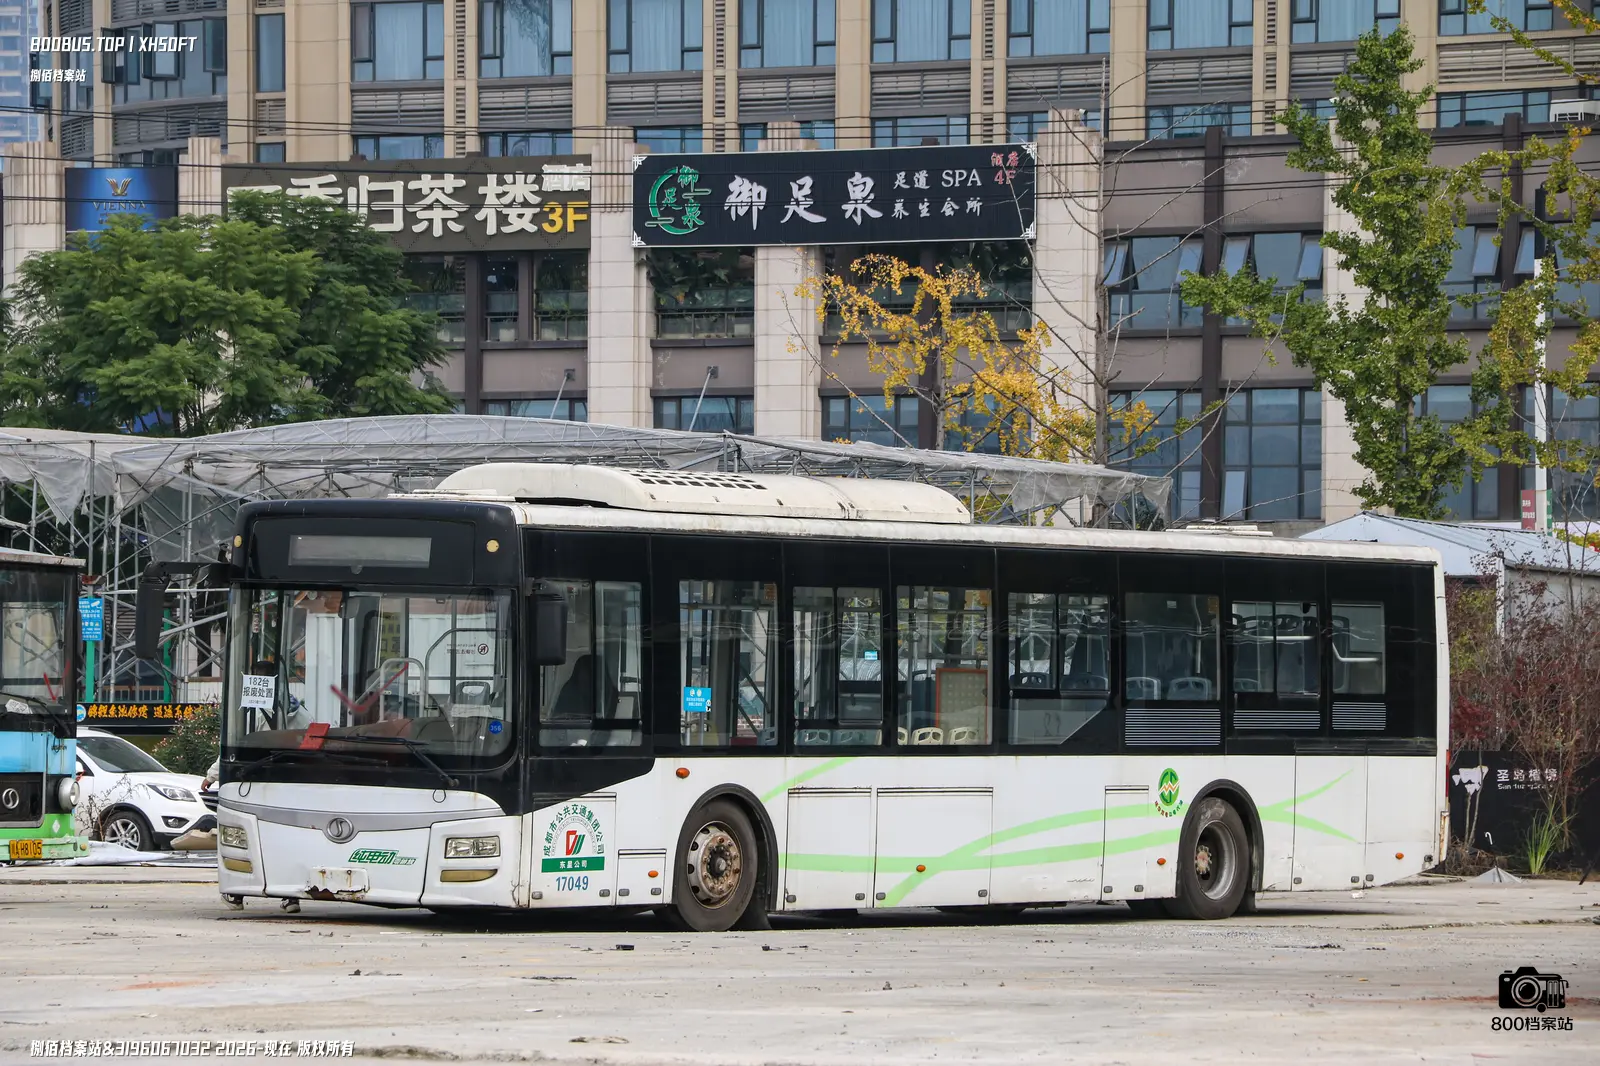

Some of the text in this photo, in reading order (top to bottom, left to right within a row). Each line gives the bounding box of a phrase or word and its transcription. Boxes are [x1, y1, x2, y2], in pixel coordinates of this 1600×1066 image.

[893, 168, 983, 190] 足道 SPA
[994, 170, 1017, 185] 4F
[93, 201, 147, 211] VIENNA
[724, 172, 884, 231] 御足泉
[891, 197, 983, 220] 养生会所
[541, 201, 590, 233] 3F
[248, 676, 270, 687] 182台
[243, 686, 274, 698] 报废处置
[543, 804, 605, 857] 成都市公共交通集团公司
[349, 850, 397, 865] 纯电动
[555, 875, 589, 892] 17049
